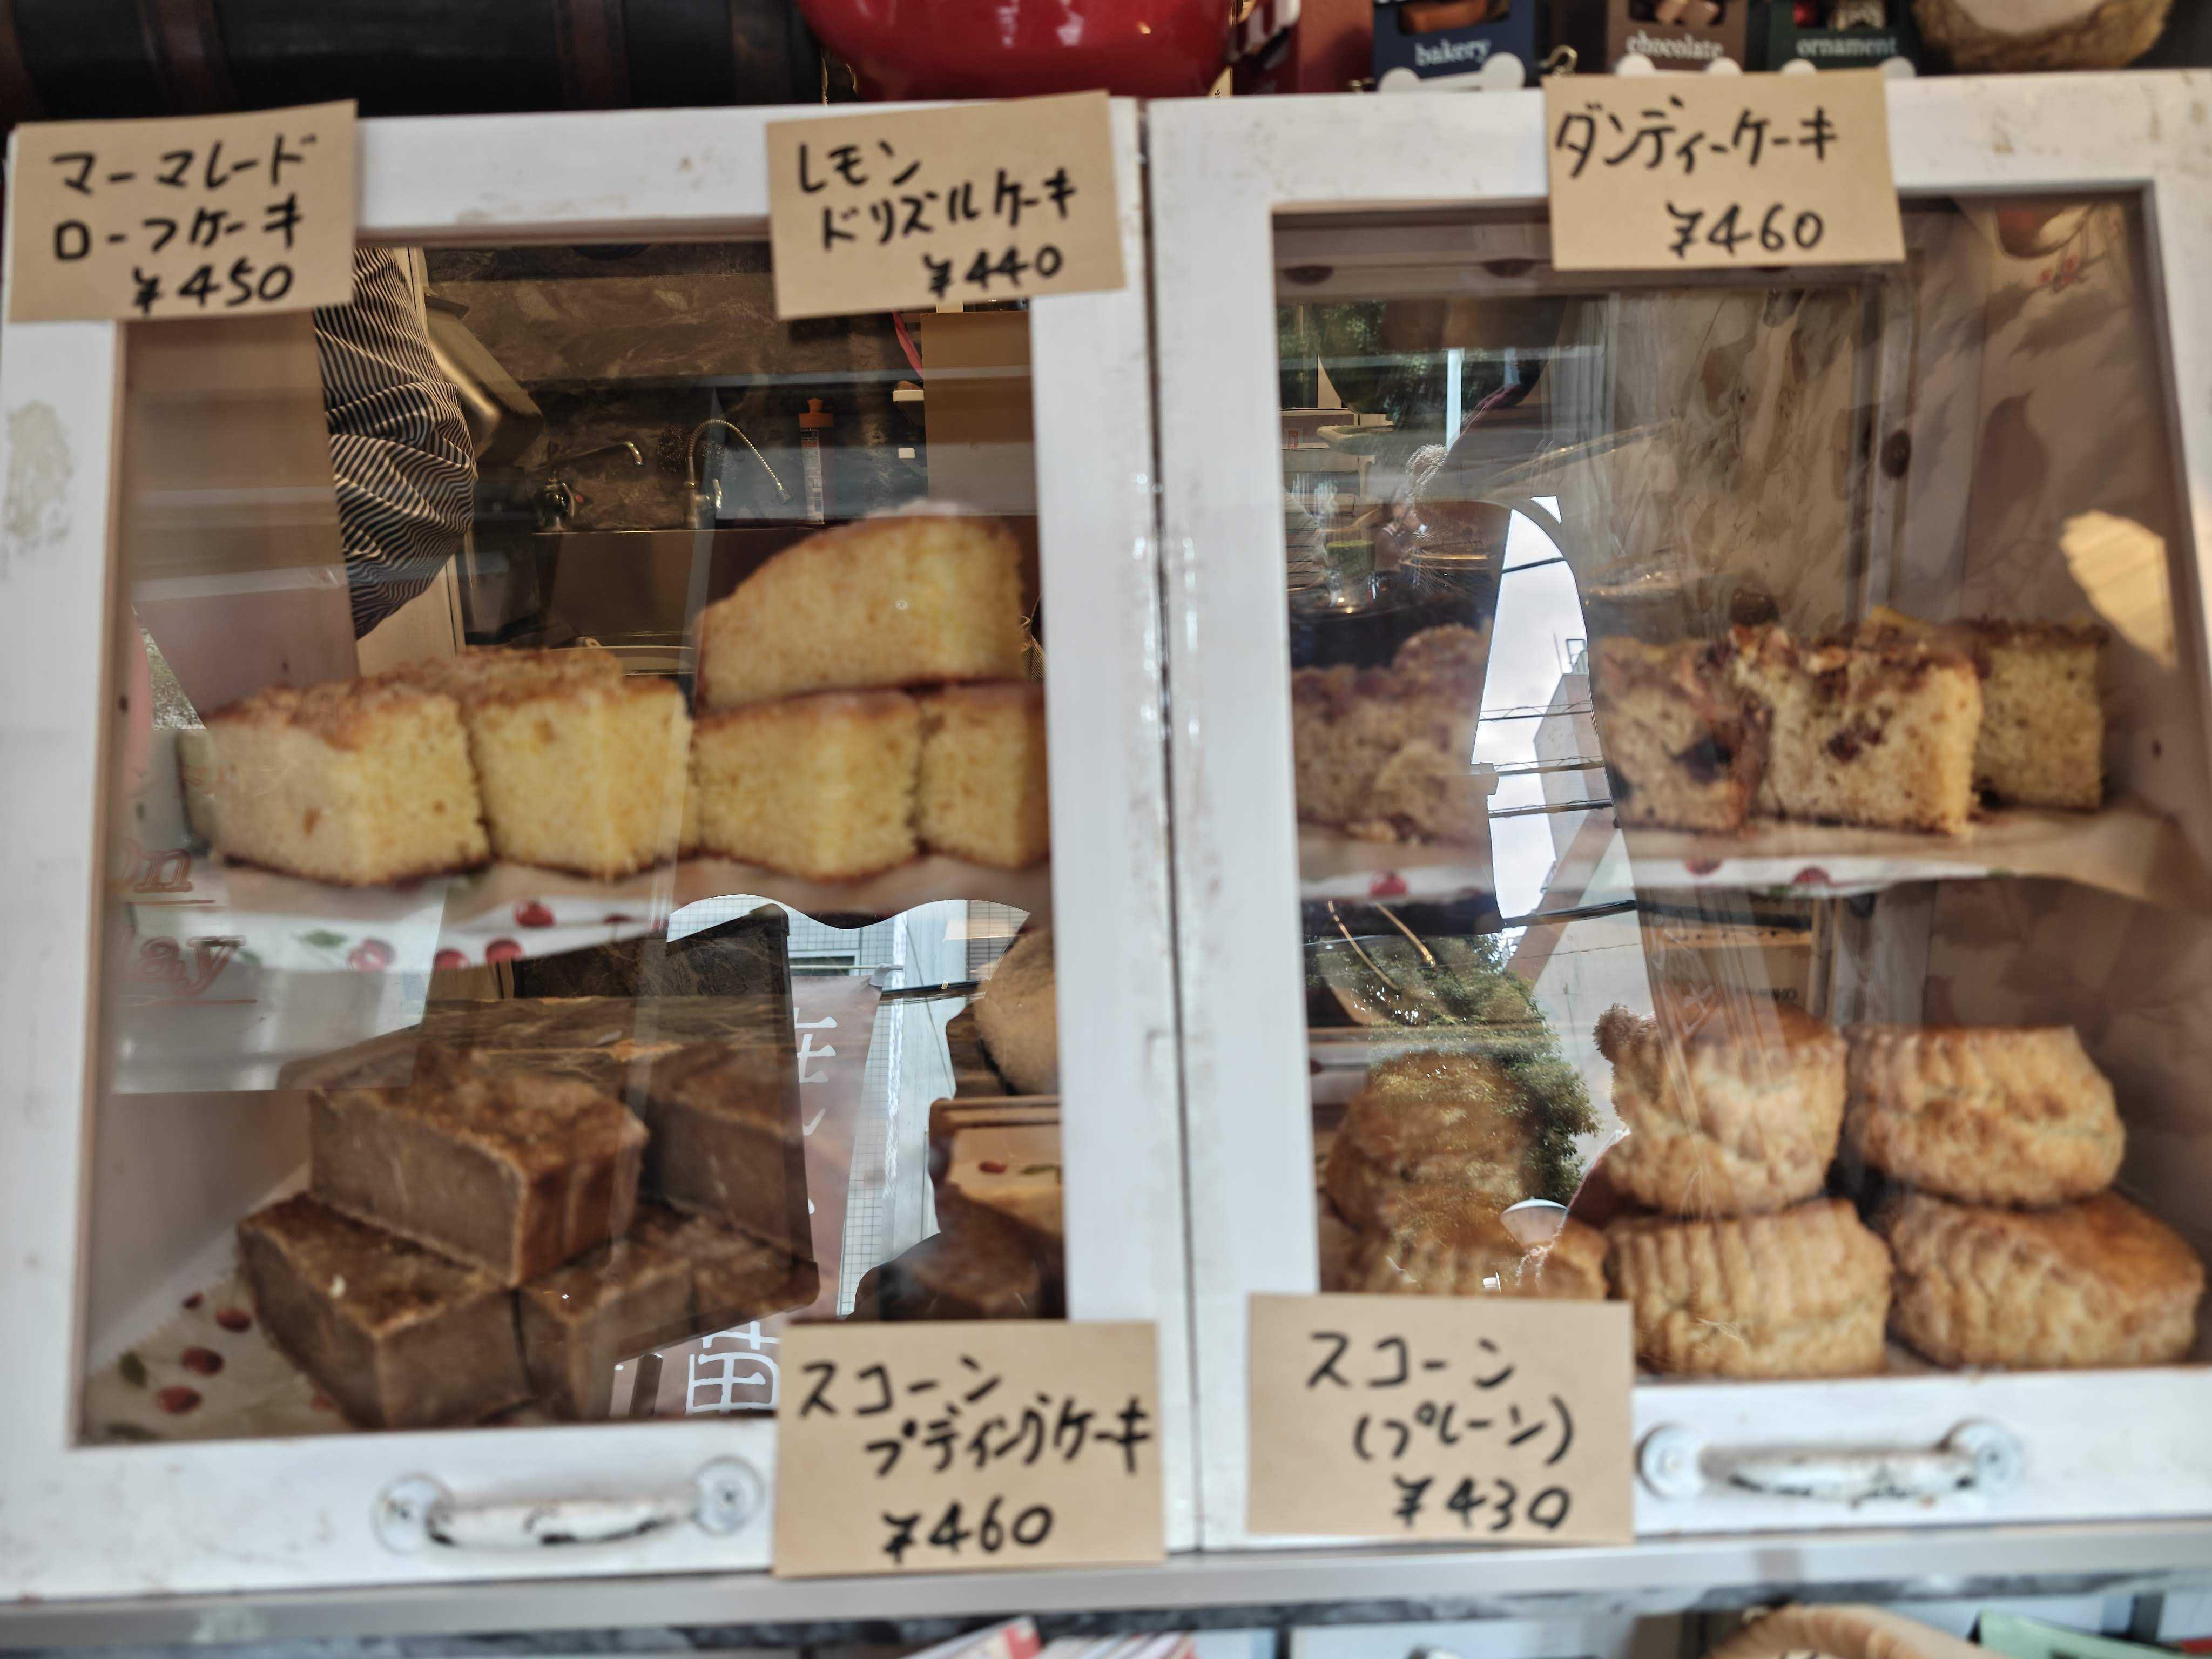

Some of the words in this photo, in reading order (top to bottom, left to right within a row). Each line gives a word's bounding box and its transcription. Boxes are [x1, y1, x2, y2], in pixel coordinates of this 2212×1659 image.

[1414, 38, 1492, 67] bakery
[1626, 30, 1724, 60] chocolate
[1796, 37, 1897, 57] ornament
[51, 133, 318, 195] マーマレード
[1555, 95, 1838, 179] ダンディーケーキ
[798, 140, 921, 194] レモン
[53, 191, 303, 261] ローフケーキ
[821, 166, 1077, 252] ドリズルケーキ
[1665, 201, 1824, 259] ¥460
[131, 256, 296, 318] ¥450
[922, 243, 1064, 300] ¥440
[799, 1354, 1003, 1418] スコーン
[1305, 1331, 1515, 1390] スコーン
[881, 1495, 1055, 1564] ¥460
[1392, 1475, 1572, 1532] ¥430
